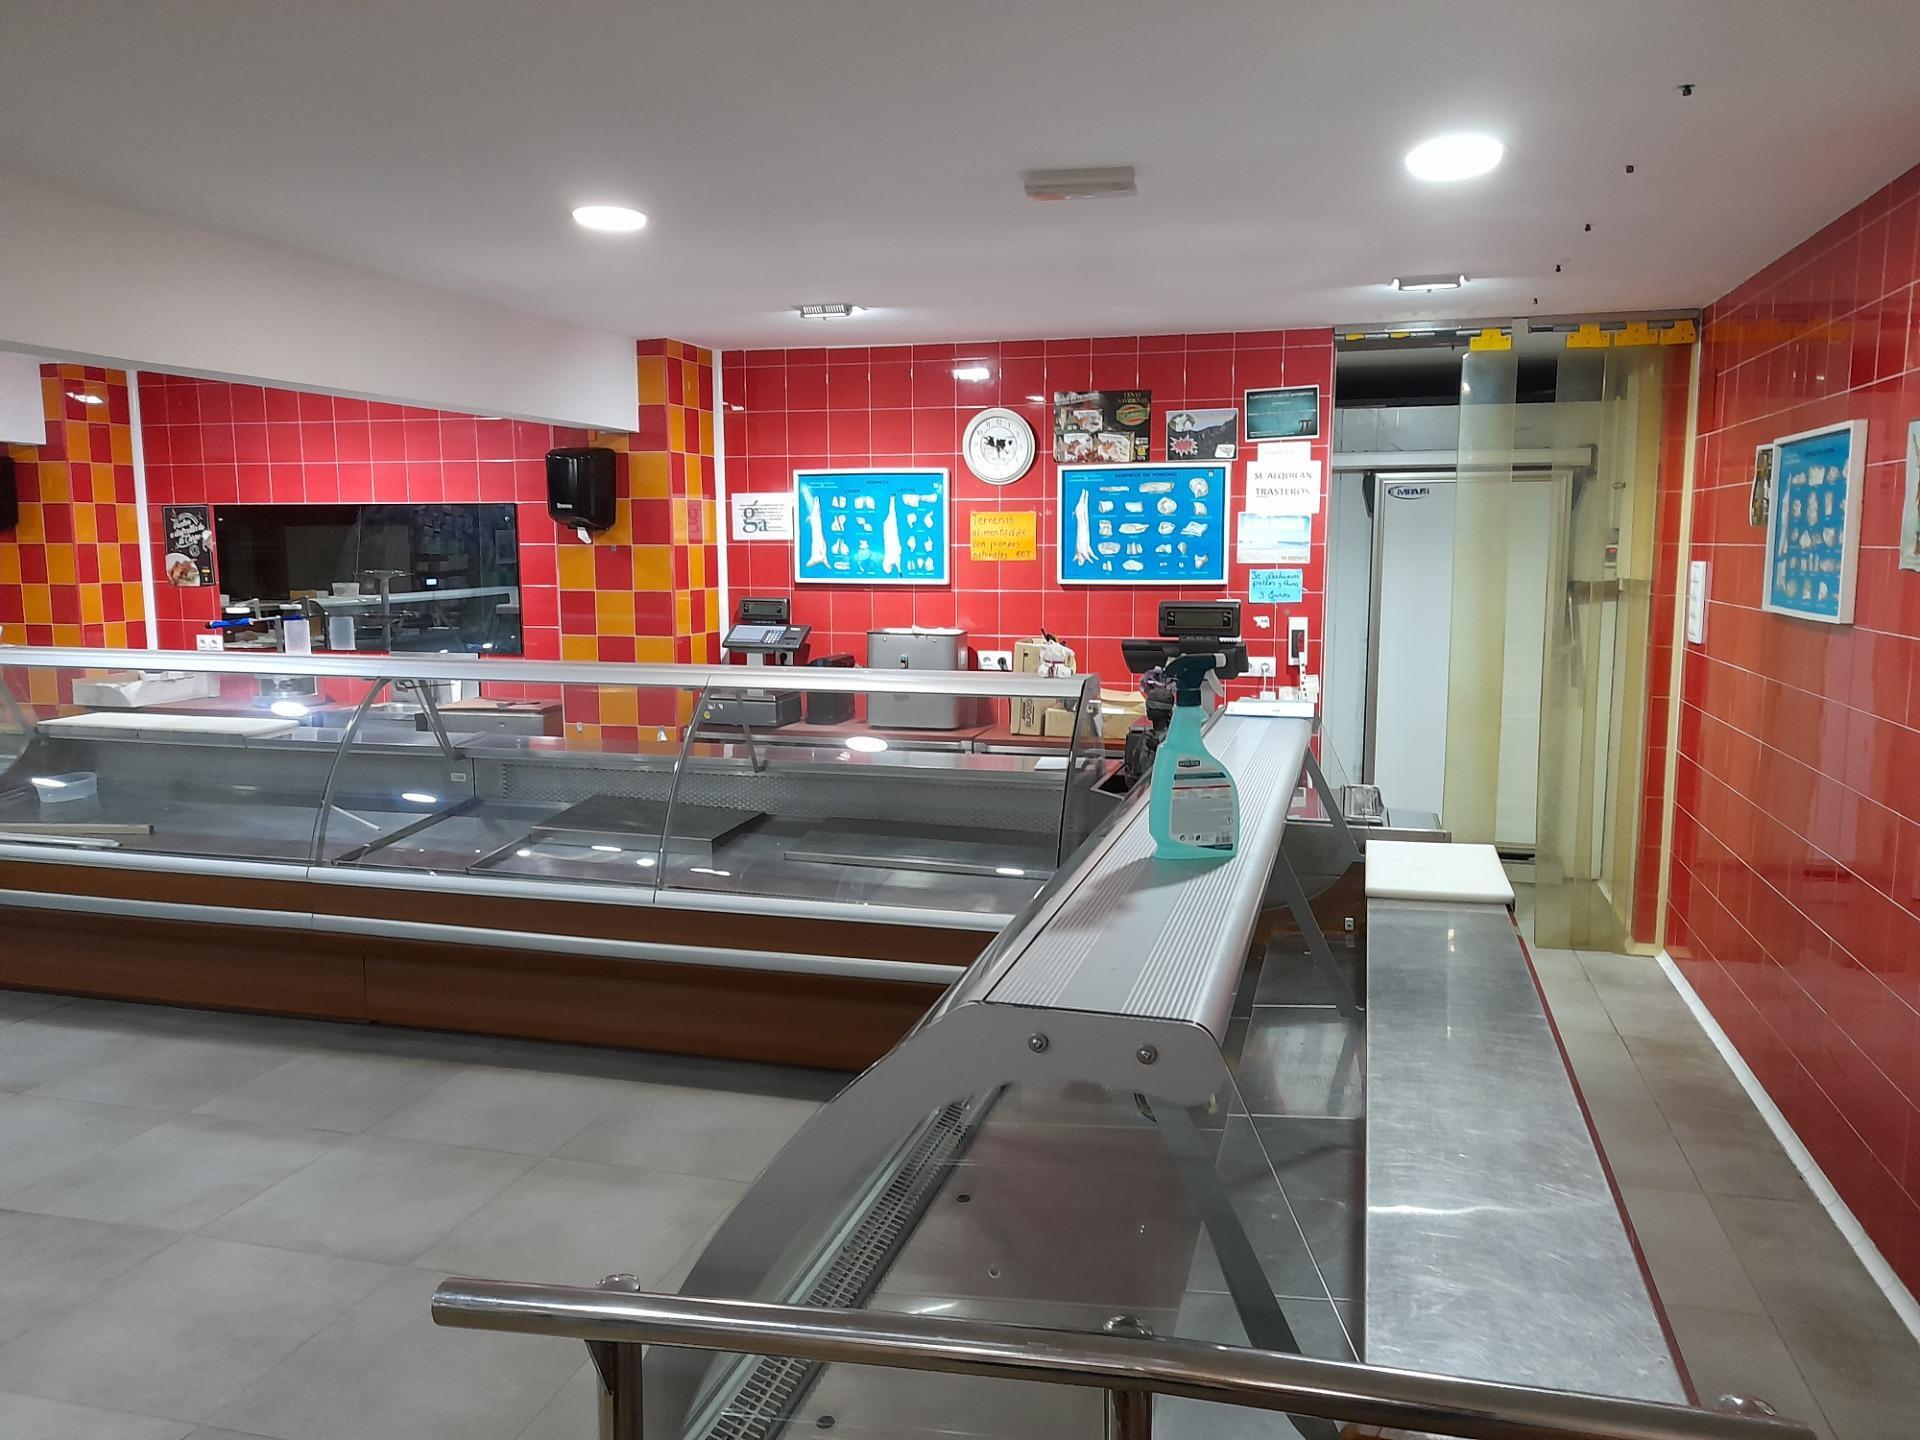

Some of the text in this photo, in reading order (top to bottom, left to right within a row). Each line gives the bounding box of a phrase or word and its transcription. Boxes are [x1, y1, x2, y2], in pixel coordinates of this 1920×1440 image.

[1254, 472, 1312, 480] SE ALQUILAN
[1255, 487, 1310, 496] TRASTEROS
